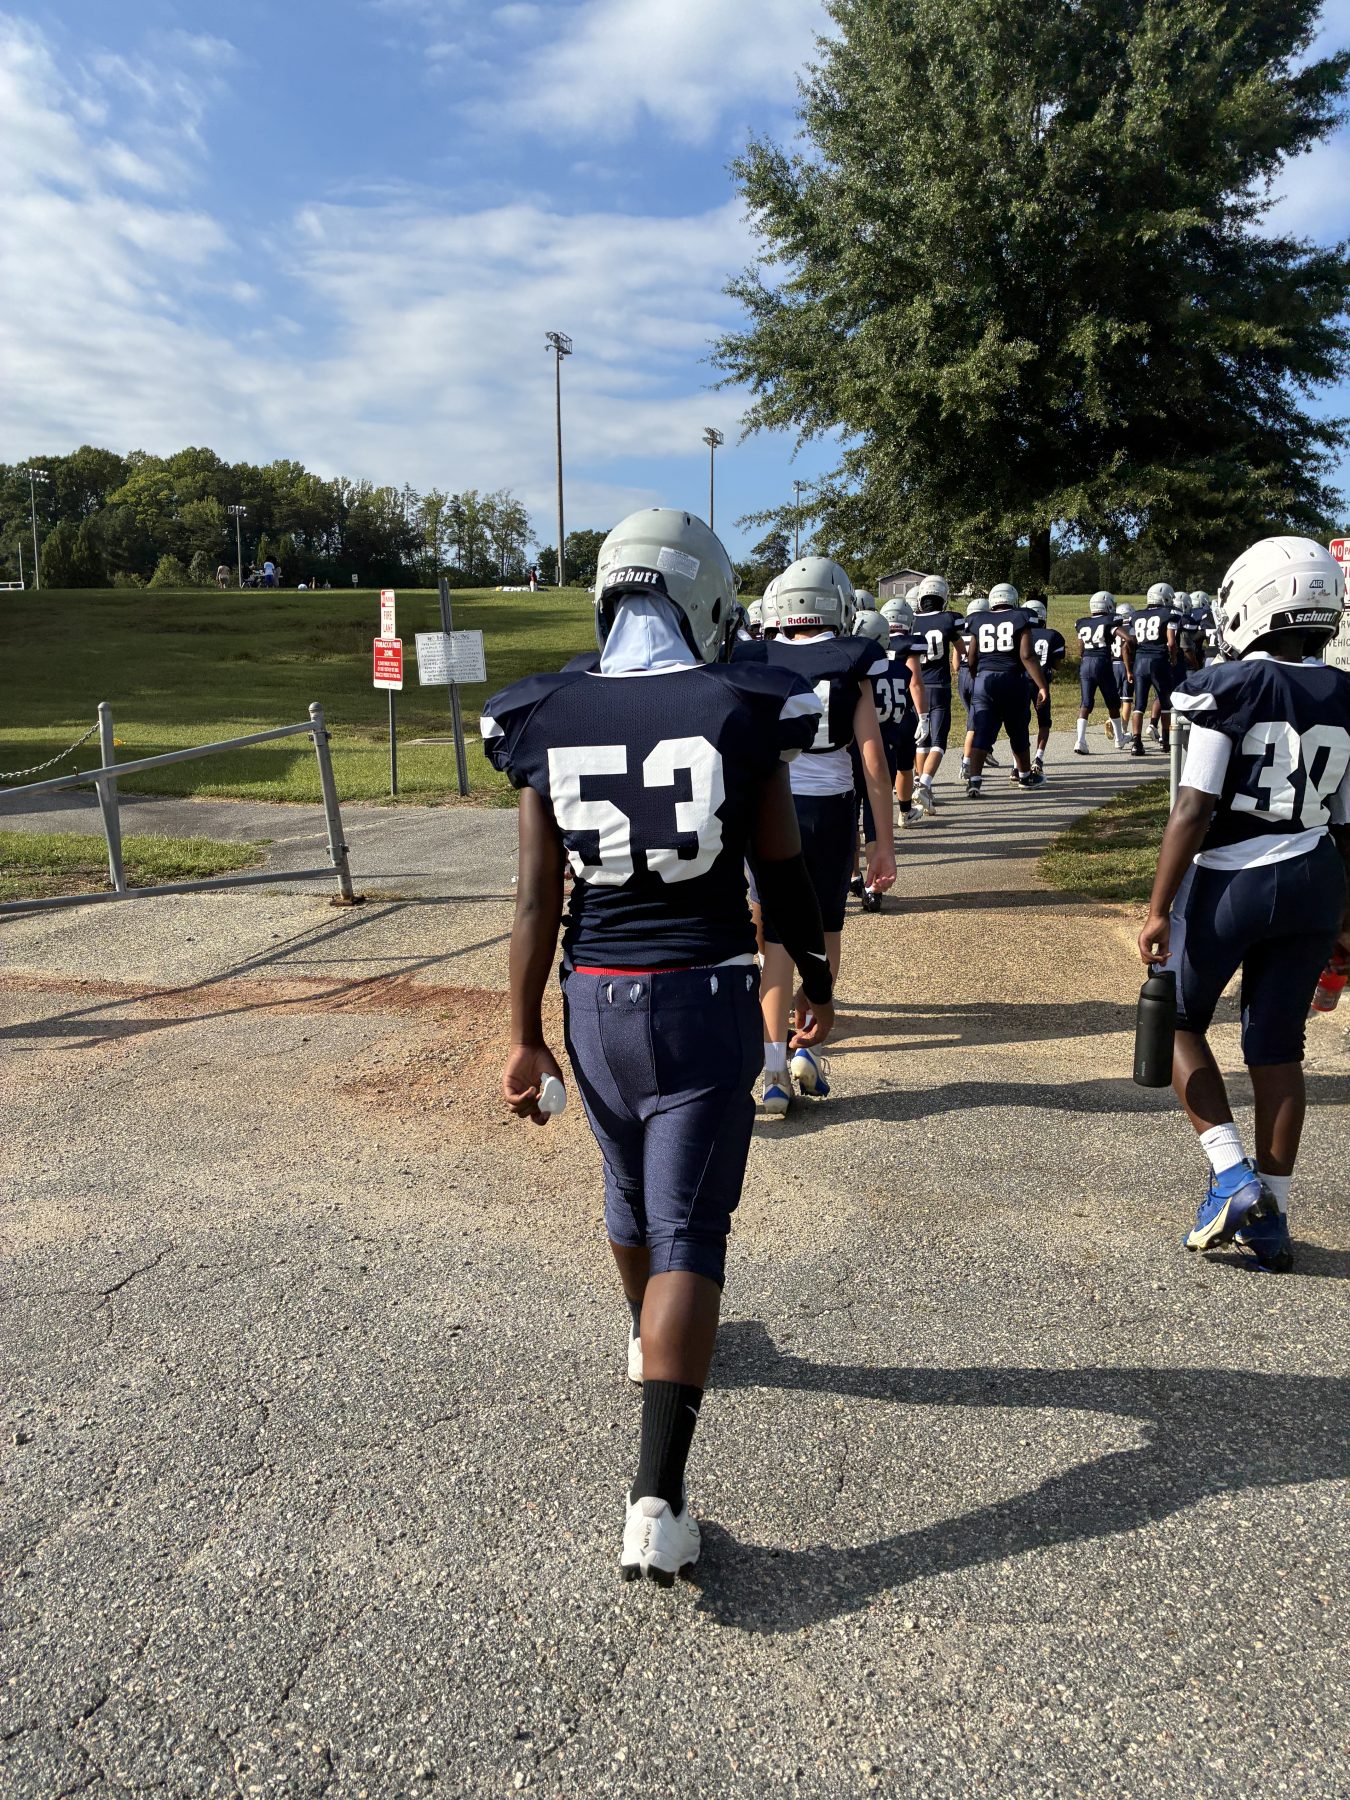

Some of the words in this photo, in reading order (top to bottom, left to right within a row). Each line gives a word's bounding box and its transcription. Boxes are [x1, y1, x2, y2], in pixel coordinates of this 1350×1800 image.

[1332, 545, 1343, 557] NO
[979, 621, 1014, 653] 68
[1078, 624, 1106, 648] 24
[1135, 616, 1160, 643] 88
[876, 678, 906, 723] 35
[1231, 722, 1350, 828] 30
[547, 736, 726, 886] 53
